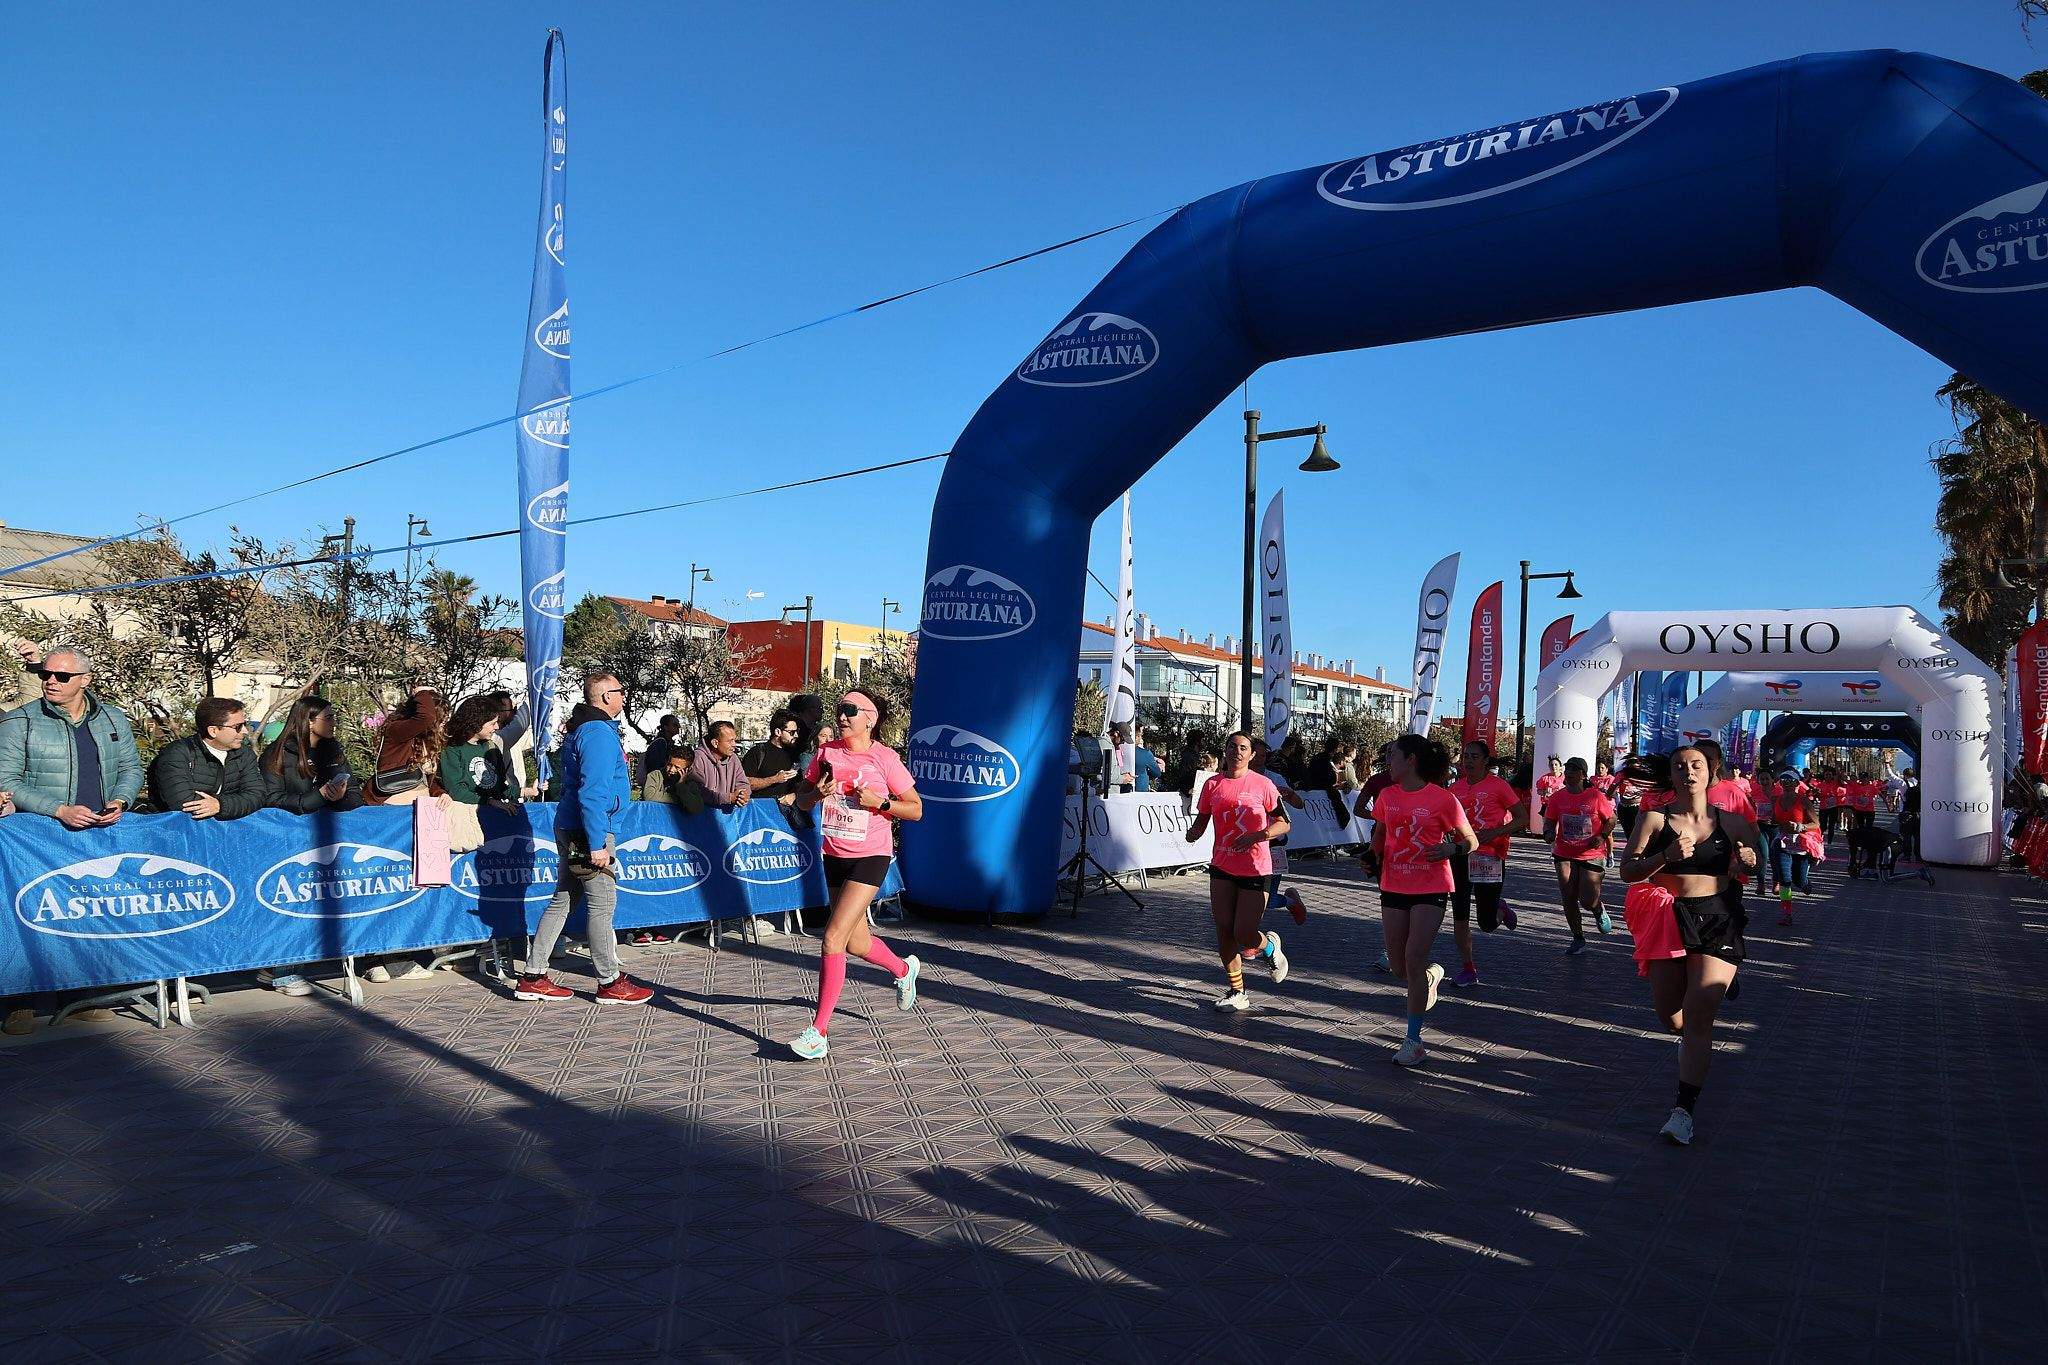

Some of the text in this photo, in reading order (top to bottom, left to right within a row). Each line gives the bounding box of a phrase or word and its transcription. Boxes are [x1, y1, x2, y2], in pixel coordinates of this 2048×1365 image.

[1336, 98, 1645, 194] ASTURIANA
[1977, 217, 2048, 240] CENTR
[1937, 232, 2048, 280] ASTU
[1046, 333, 1141, 351] CENTRAL LECHERA
[1022, 344, 1147, 375] ASTURIANA
[970, 591, 1021, 603] LECHERA
[1659, 622, 1840, 655] OYSHO
[1478, 608, 1493, 692] Santander
[1561, 659, 1610, 671] OYSHO
[1897, 657, 1959, 669] OYSHO
[2033, 642, 2048, 721] Santander
[1538, 718, 1583, 731] OYSHO
[1808, 722, 1891, 731] VOLVO
[1931, 729, 1990, 742] OYSHO
[953, 752, 1004, 764] LECHERA
[911, 759, 1008, 787] STURIANA
[1931, 800, 1989, 814] OYSHO
[664, 853, 699, 862] LECHERA
[745, 847, 774, 855] CENTRAL
[613, 857, 706, 881] ASTURIANA
[732, 852, 808, 873] ASTURIANA
[298, 865, 413, 879] CENTRAL LECHERA
[69, 878, 213, 893] CENTRAL LECHERA
[32, 888, 223, 923] ASTURIANA
